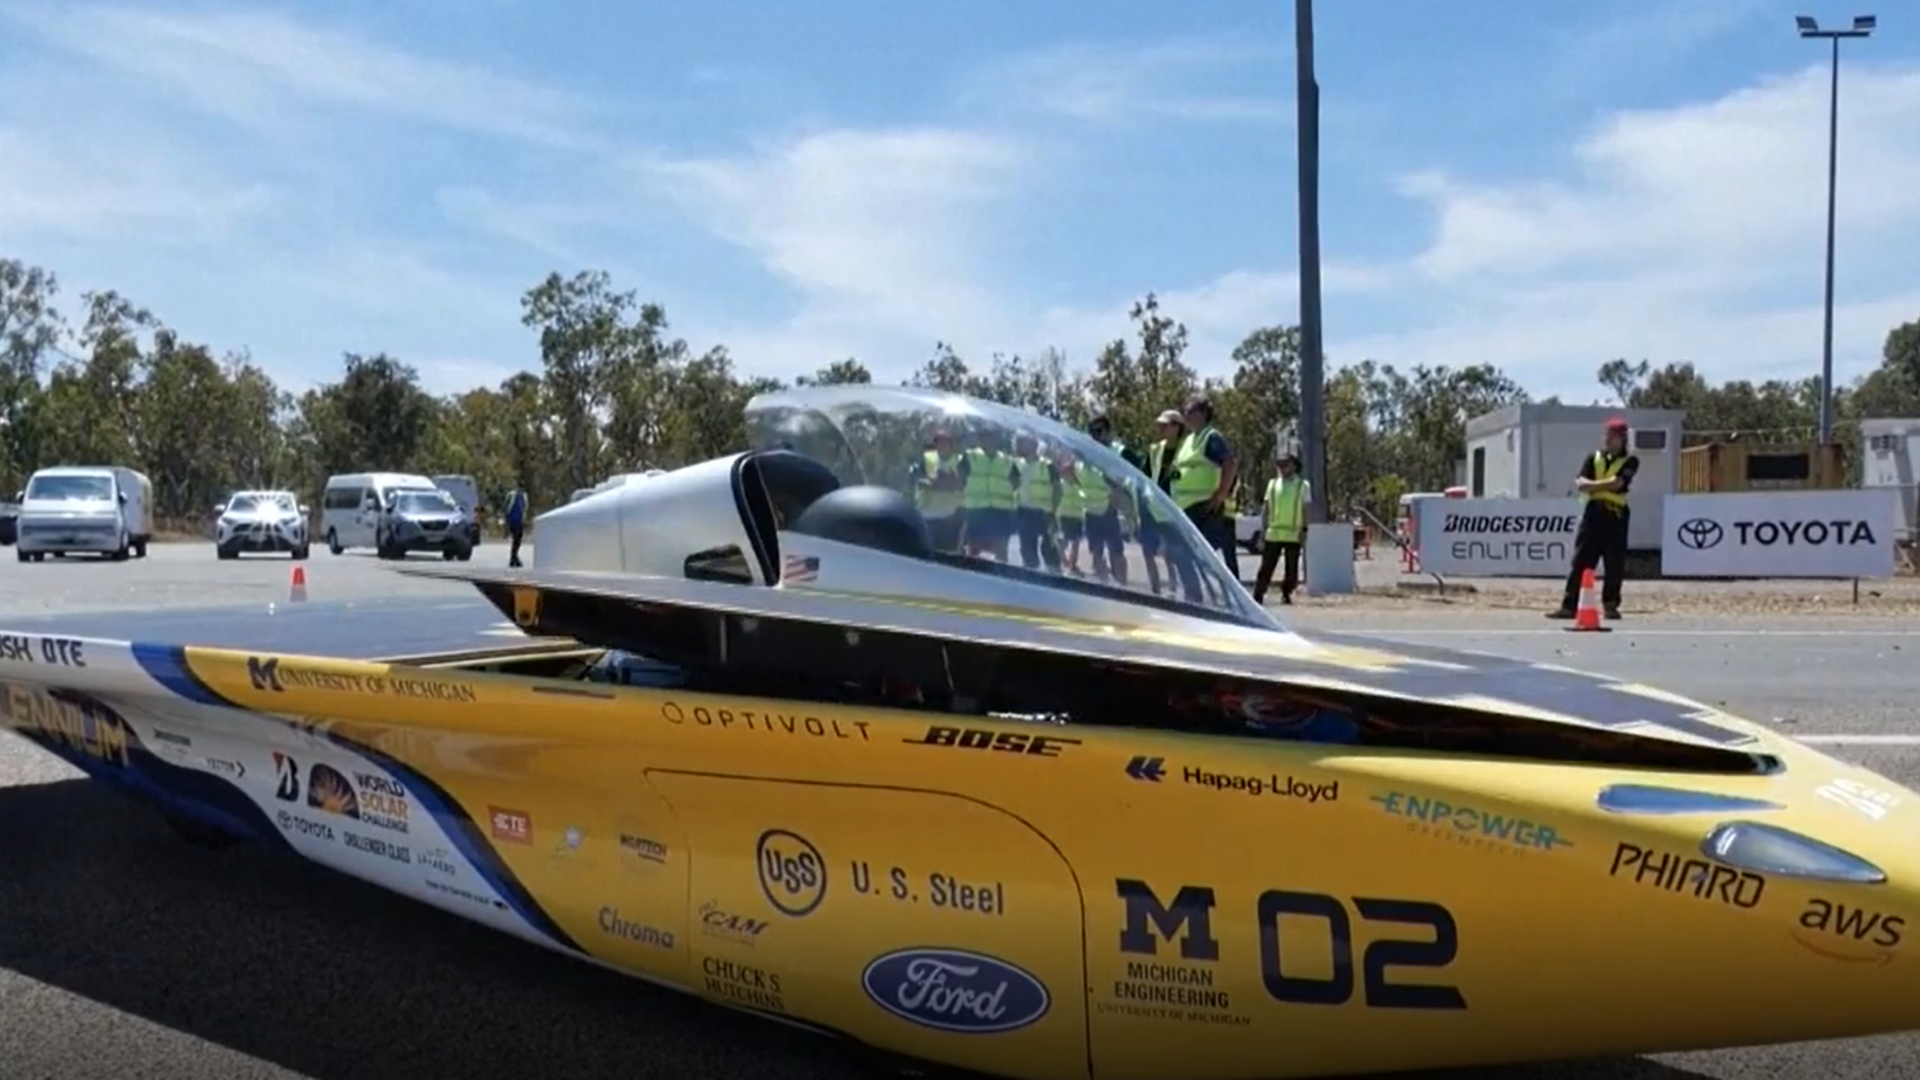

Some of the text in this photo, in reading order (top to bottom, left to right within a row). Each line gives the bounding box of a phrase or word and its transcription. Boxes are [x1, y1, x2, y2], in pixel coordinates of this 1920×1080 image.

[1444, 514, 1577, 533] BRIDGESTONE
[1733, 520, 1876, 545] TOYOTA
[1452, 541, 1565, 560] ENLITEN
[0, 635, 33, 662] SH
[280, 669, 362, 692] UNIVERSITY
[367, 676, 387, 694] OF
[391, 677, 477, 702] MICHIGAN
[694, 707, 870, 740] OPTIVOLT
[903, 726, 1082, 757] BOSE
[354, 771, 404, 797] WORLD
[1183, 767, 1338, 801] Hapag-Lloyd
[359, 792, 408, 818] SOLAR
[1384, 791, 1558, 850] ENPOWER
[294, 815, 334, 841] TOYOTA
[360, 812, 409, 834] CHALLENGE
[766, 848, 817, 893] USS
[930, 873, 1003, 915] Steel
[599, 906, 674, 948] Chroma
[1115, 878, 1219, 961] M
[1800, 899, 1905, 946] aws
[1258, 889, 1468, 1009] 02
[703, 957, 765, 989] CHUCK
[1128, 963, 1213, 986] MICHIGAN
[898, 959, 1006, 1019] Ford
[1114, 981, 1229, 1008] ENGINEERING
[1098, 1003, 1251, 1025] UNIVERSITY OF MICHIGAN
